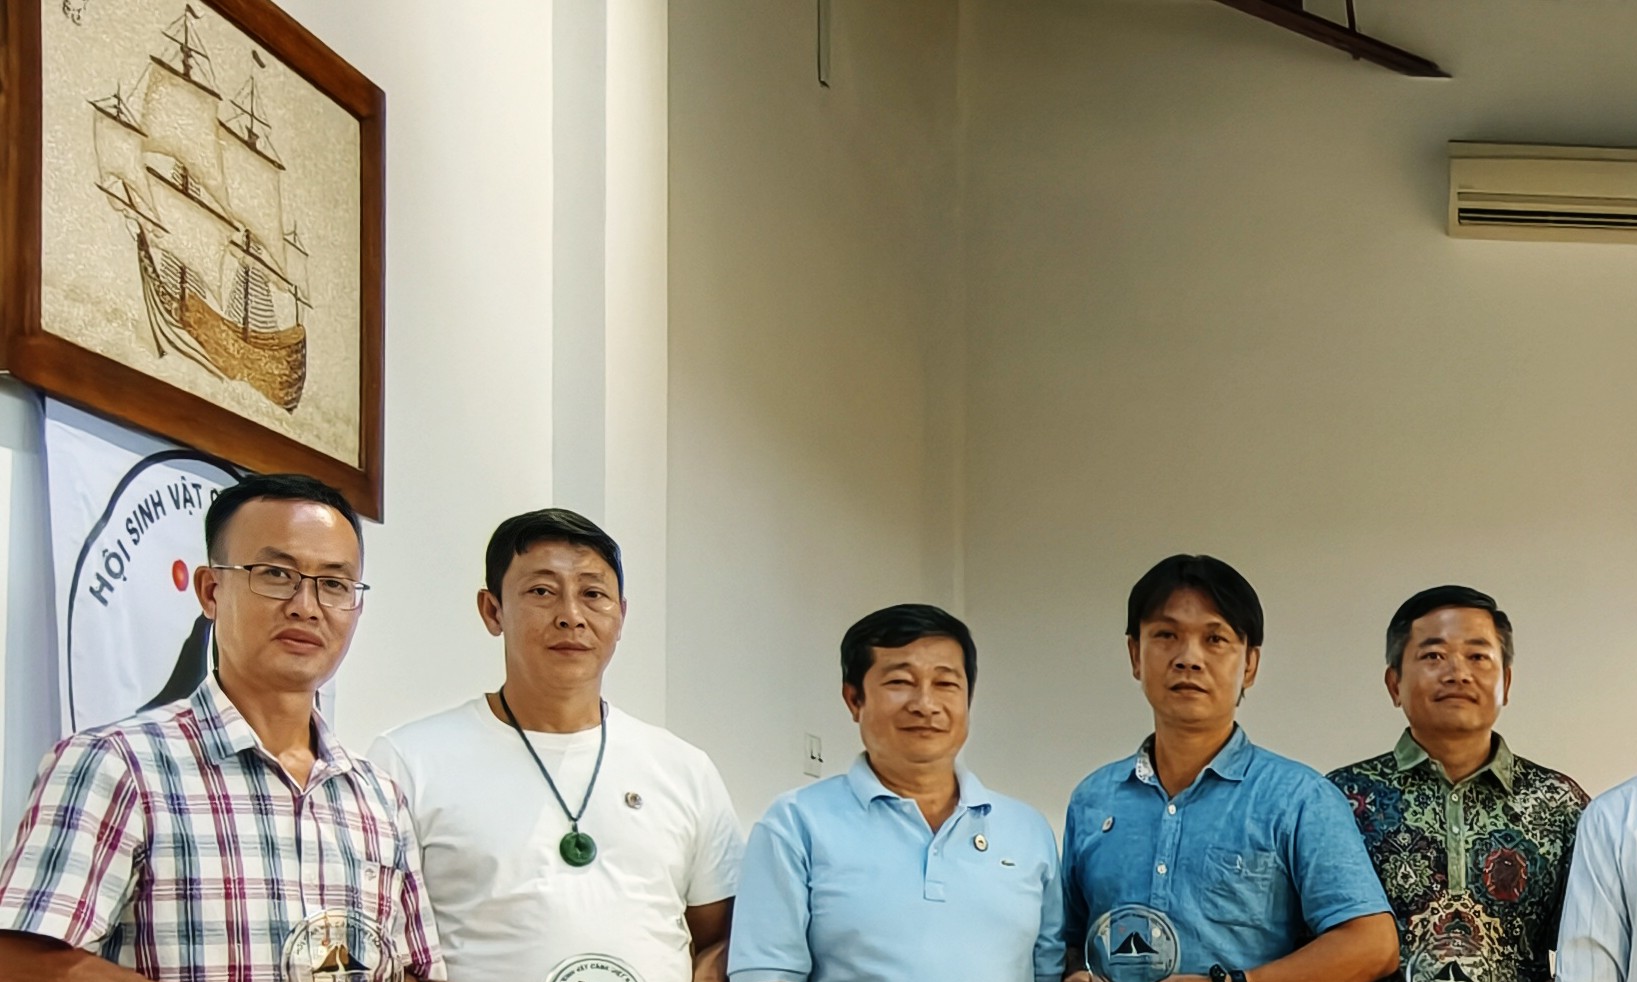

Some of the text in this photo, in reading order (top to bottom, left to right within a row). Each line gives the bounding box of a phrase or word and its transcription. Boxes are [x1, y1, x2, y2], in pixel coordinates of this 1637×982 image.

[89, 475, 202, 607] HỘI SINH VẬT
